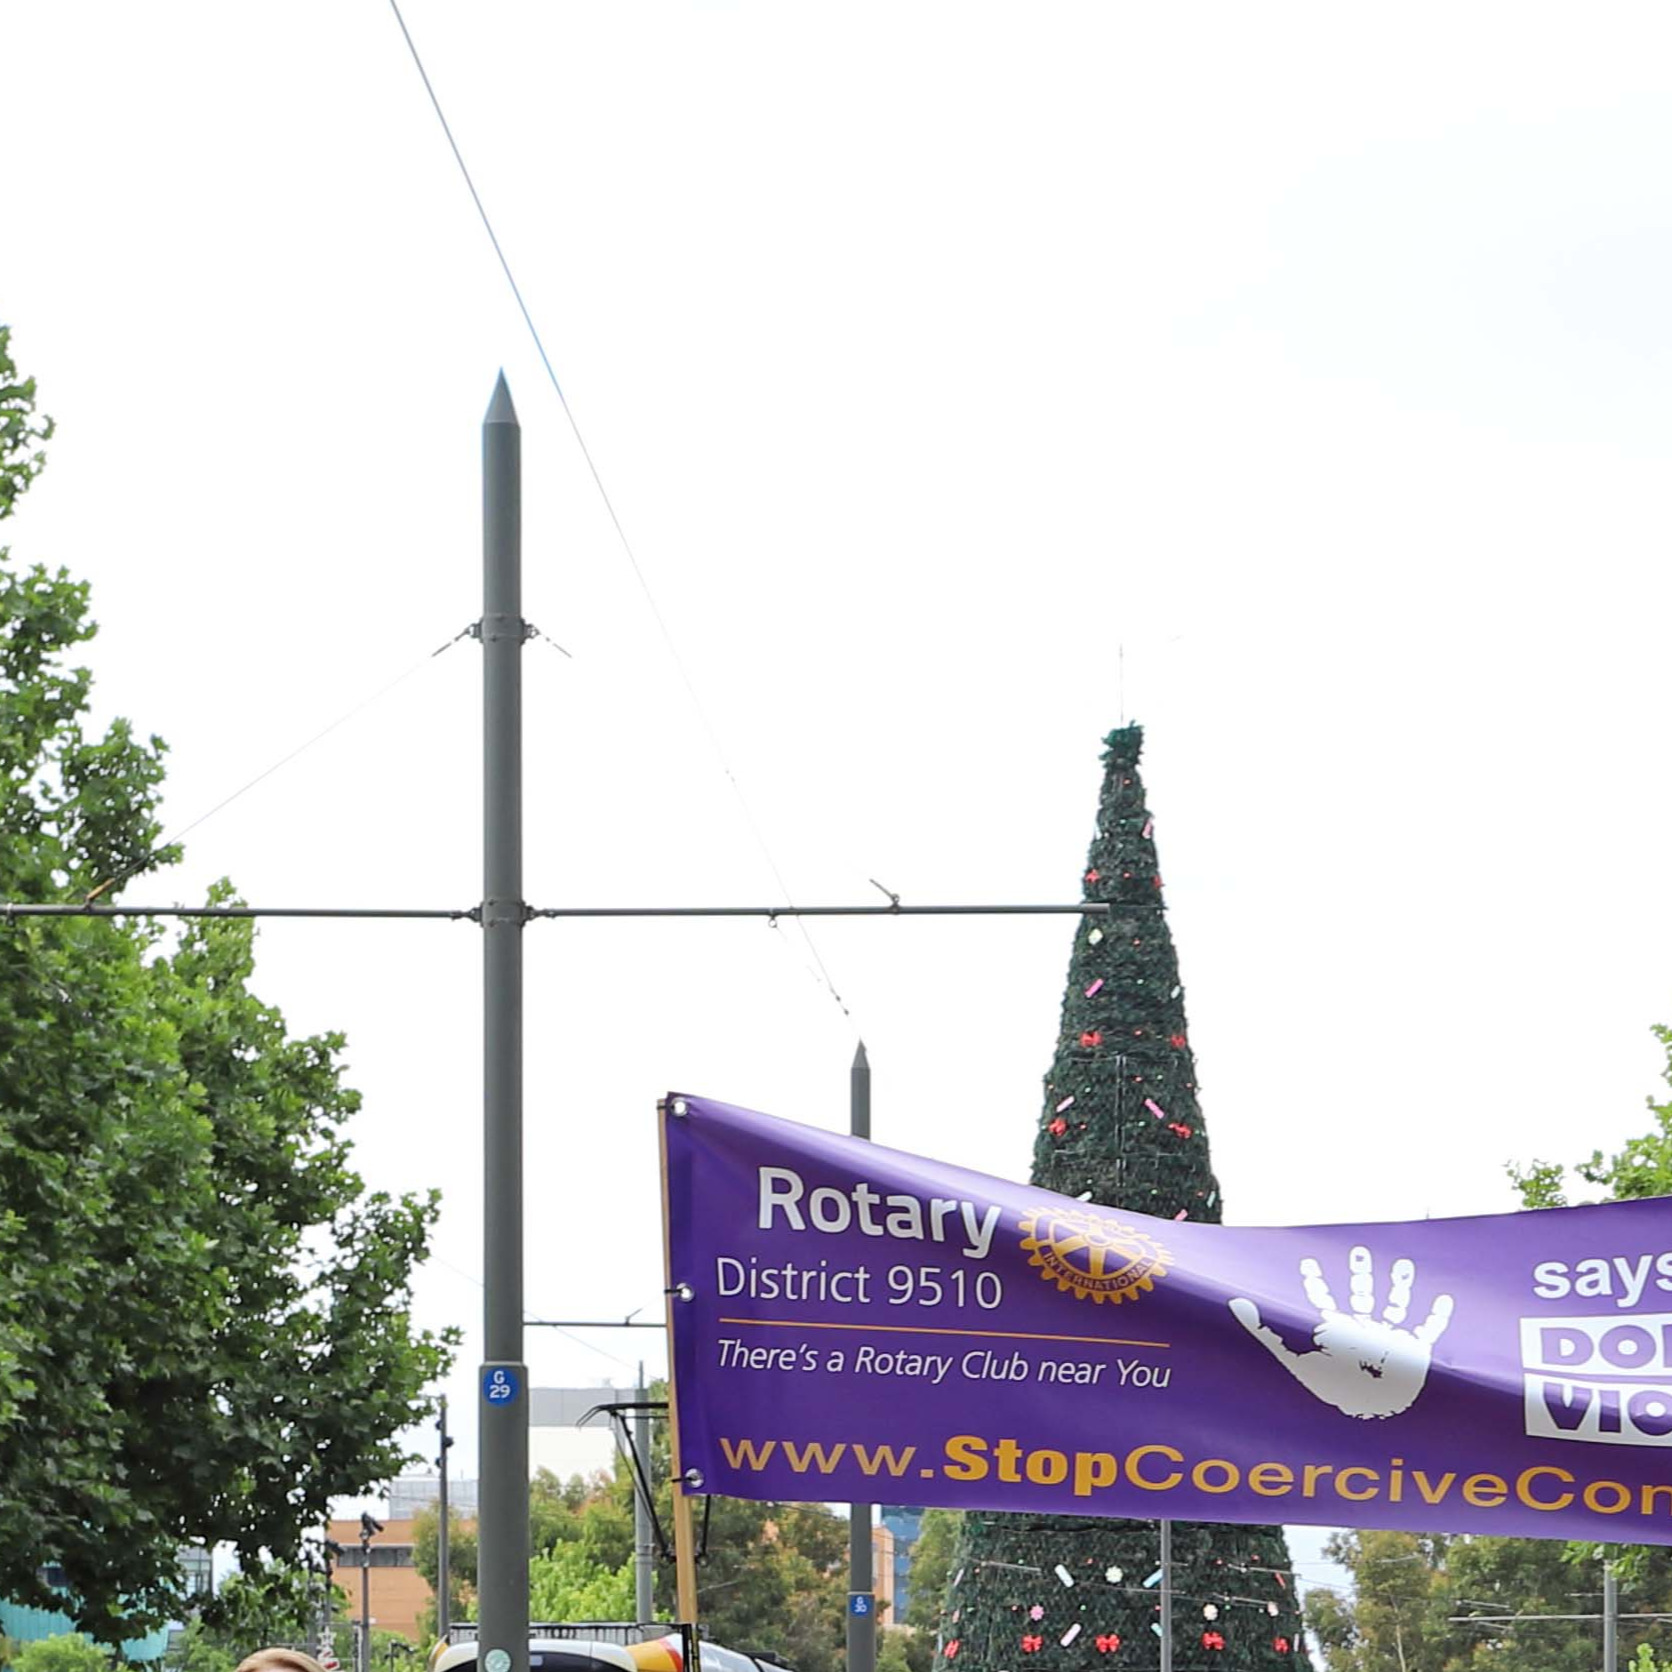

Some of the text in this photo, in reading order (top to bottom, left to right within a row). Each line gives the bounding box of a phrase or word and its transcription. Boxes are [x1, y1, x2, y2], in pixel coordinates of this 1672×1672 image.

[757, 1165, 1001, 1259] Rotary
[716, 1256, 1002, 1310] District 9510
[1044, 1252, 1152, 1291] INTERNATIONAL
[494, 1371, 505, 1384] G
[717, 1338, 1171, 1388] There's a Rotary Club near You
[489, 1385, 511, 1398] 29
